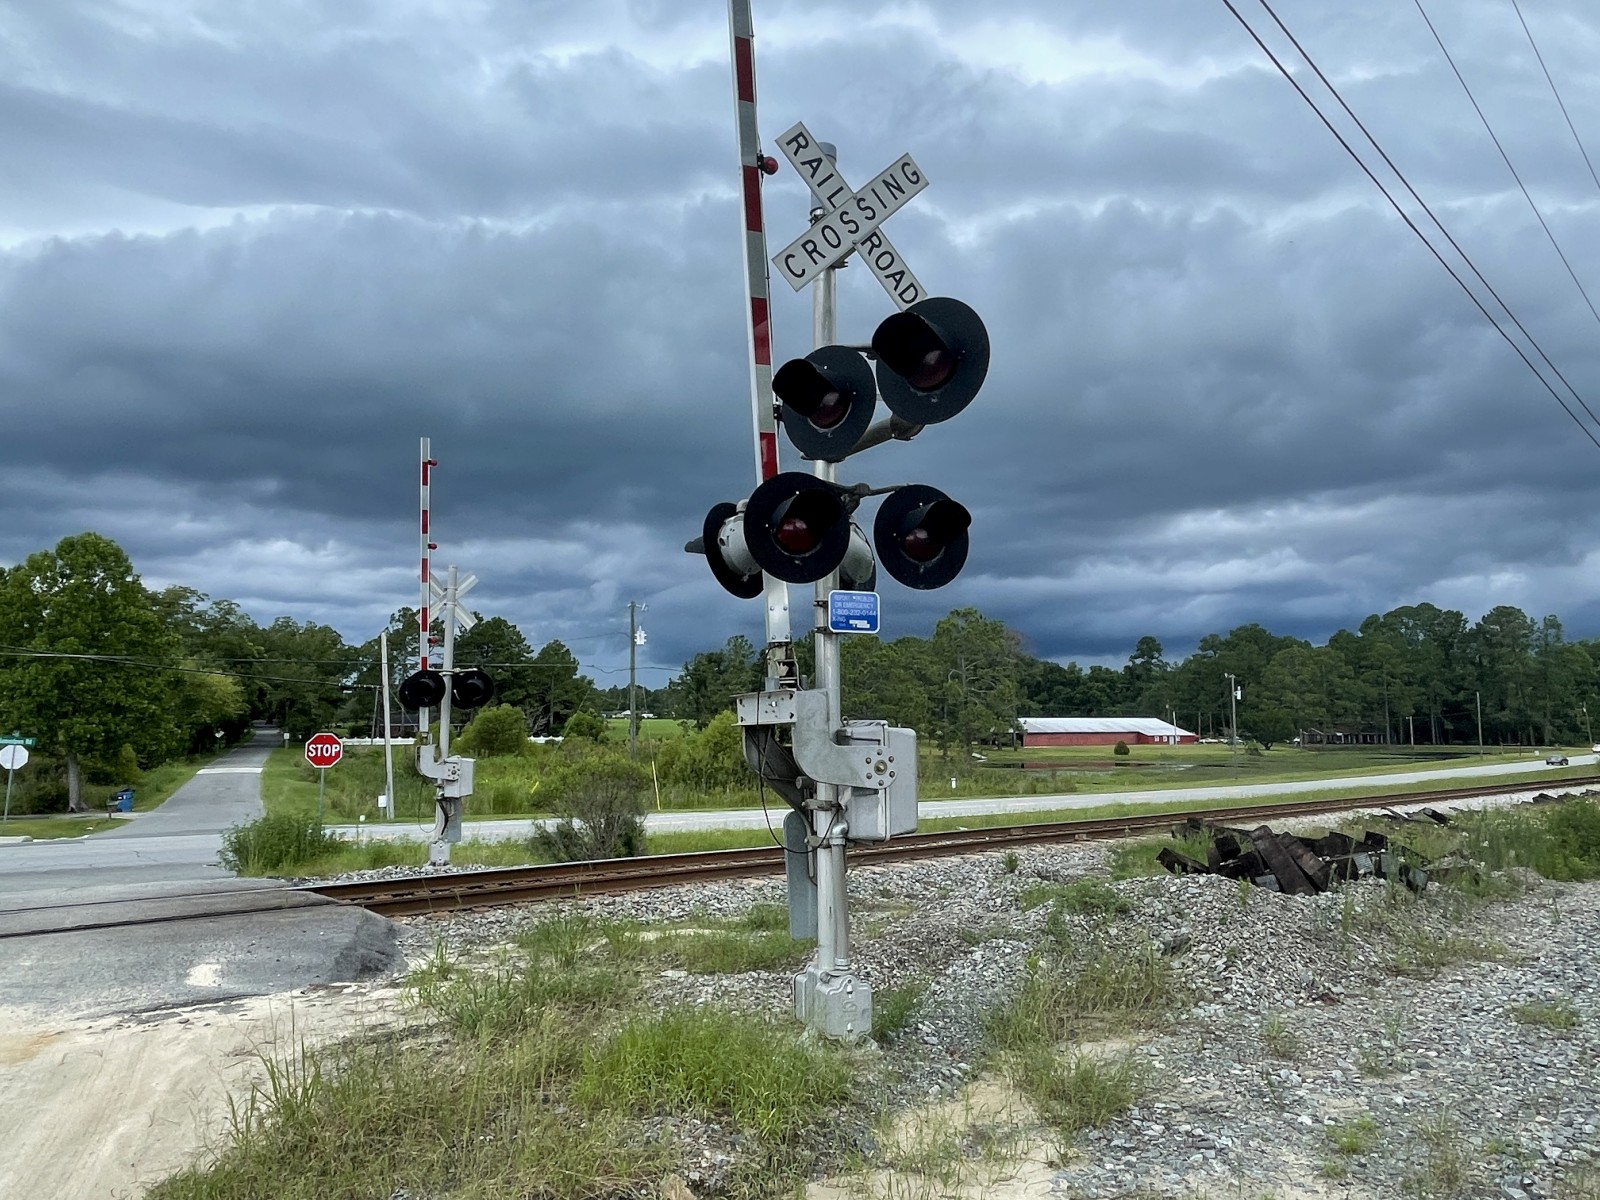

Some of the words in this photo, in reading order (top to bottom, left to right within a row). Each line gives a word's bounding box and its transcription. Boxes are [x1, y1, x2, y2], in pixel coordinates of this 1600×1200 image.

[786, 131, 844, 209] RAIL
[784, 161, 921, 279] CROSSING
[860, 231, 919, 305] ROAD
[308, 744, 340, 757] STOP
